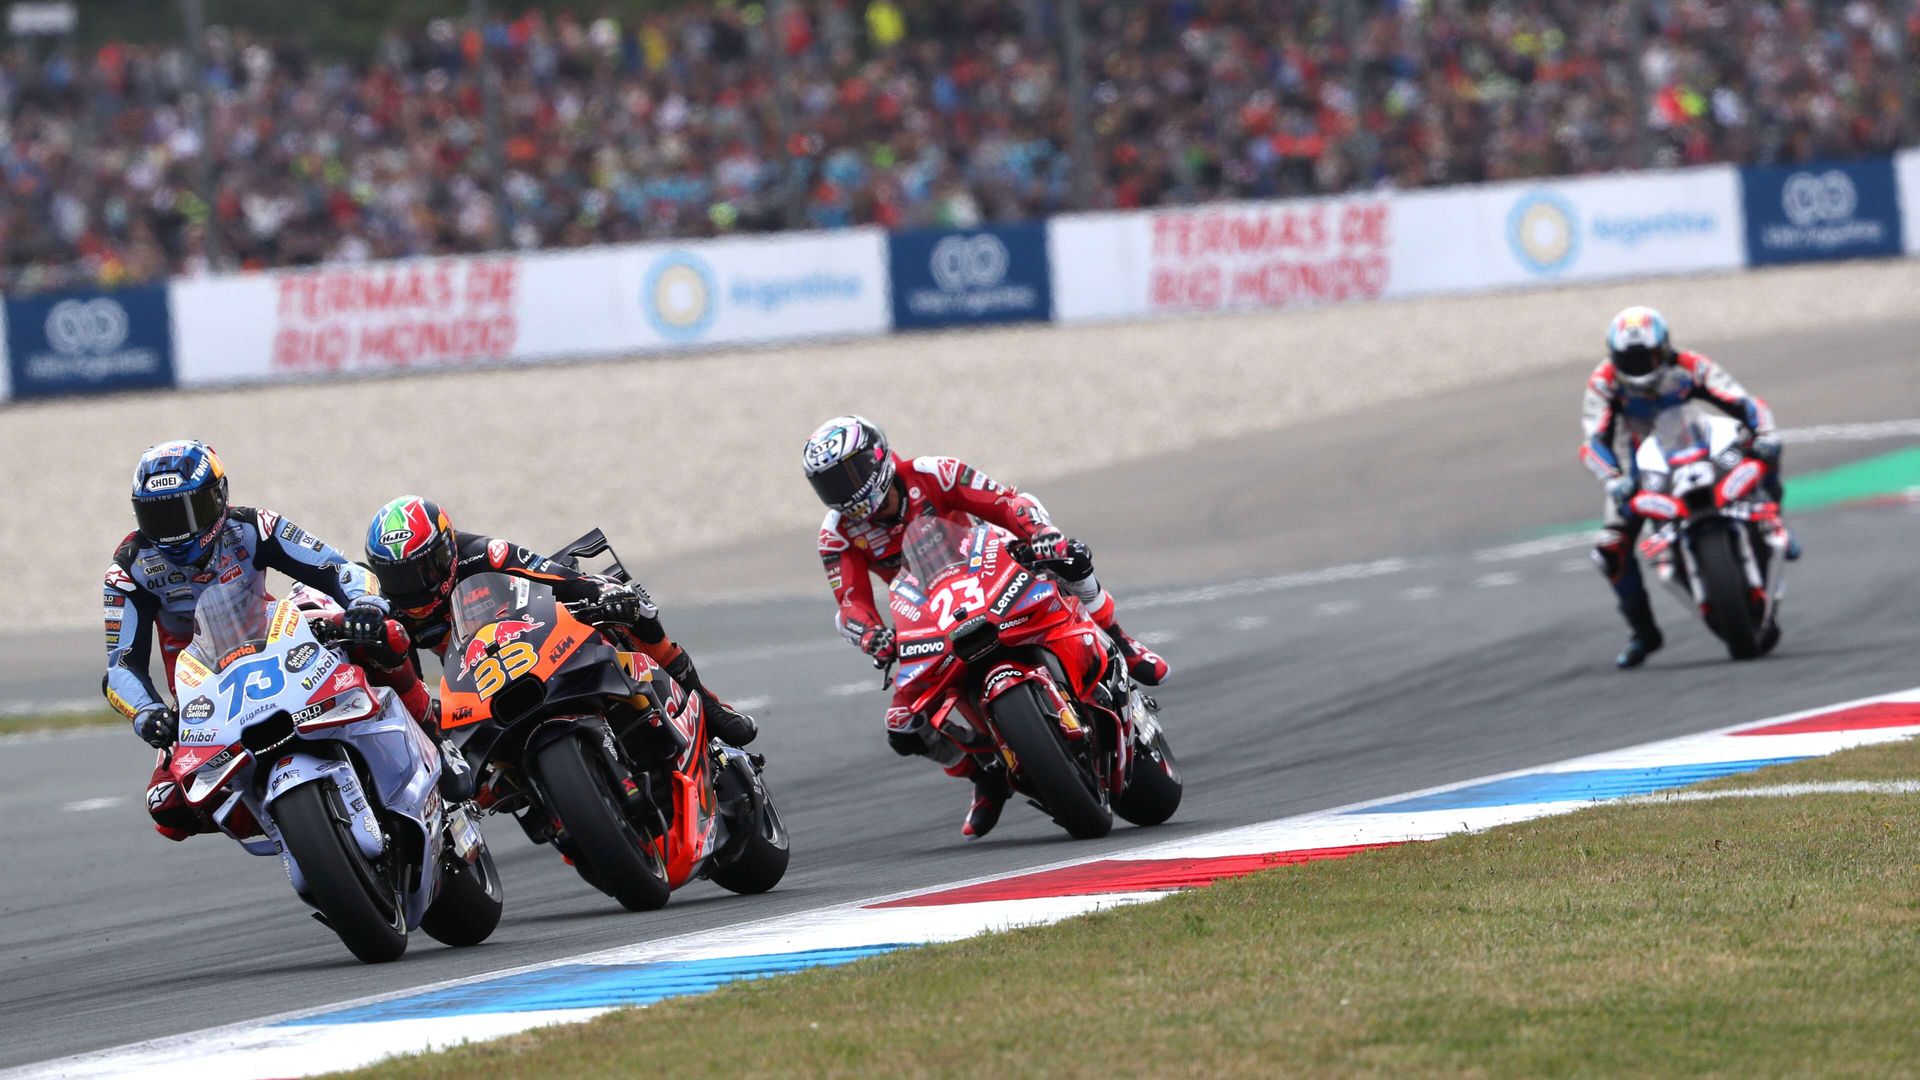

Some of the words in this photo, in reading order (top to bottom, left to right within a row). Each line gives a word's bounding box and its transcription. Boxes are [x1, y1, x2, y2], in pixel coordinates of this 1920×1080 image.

[1152, 206, 1325, 257] TERMAS
[1341, 200, 1389, 248] DE
[278, 265, 452, 320] TERMAS
[467, 258, 517, 306] DE
[1150, 264, 1221, 309] RIO
[1232, 250, 1389, 307] HONDO
[273, 326, 350, 373] RIO
[360, 312, 518, 364] HONDO
[150, 477, 177, 489] SHOEI
[382, 531, 409, 543] HJC
[145, 563, 166, 575] SHOEI
[462, 586, 491, 607] KTM
[930, 576, 986, 633] 23
[990, 572, 1029, 616] Lenovo
[1033, 588, 1053, 601] TIM
[269, 601, 290, 640] Antangin
[219, 644, 257, 670] Kapriol
[288, 645, 310, 666] Estrella
[294, 648, 315, 669] Galicia
[549, 635, 576, 664] KTM
[900, 641, 944, 658] Lenovo
[301, 654, 336, 690] Unibat
[473, 641, 540, 702] 33
[908, 664, 925, 680] TIM
[217, 654, 286, 724] 73
[984, 669, 1023, 697] Lenovo
[186, 710, 209, 719] Galicia
[187, 702, 211, 712] Estrella
[291, 705, 321, 722] BOLD
[452, 705, 473, 722] KTM
[180, 729, 217, 743] Unibat
[208, 750, 231, 768] BOLD
